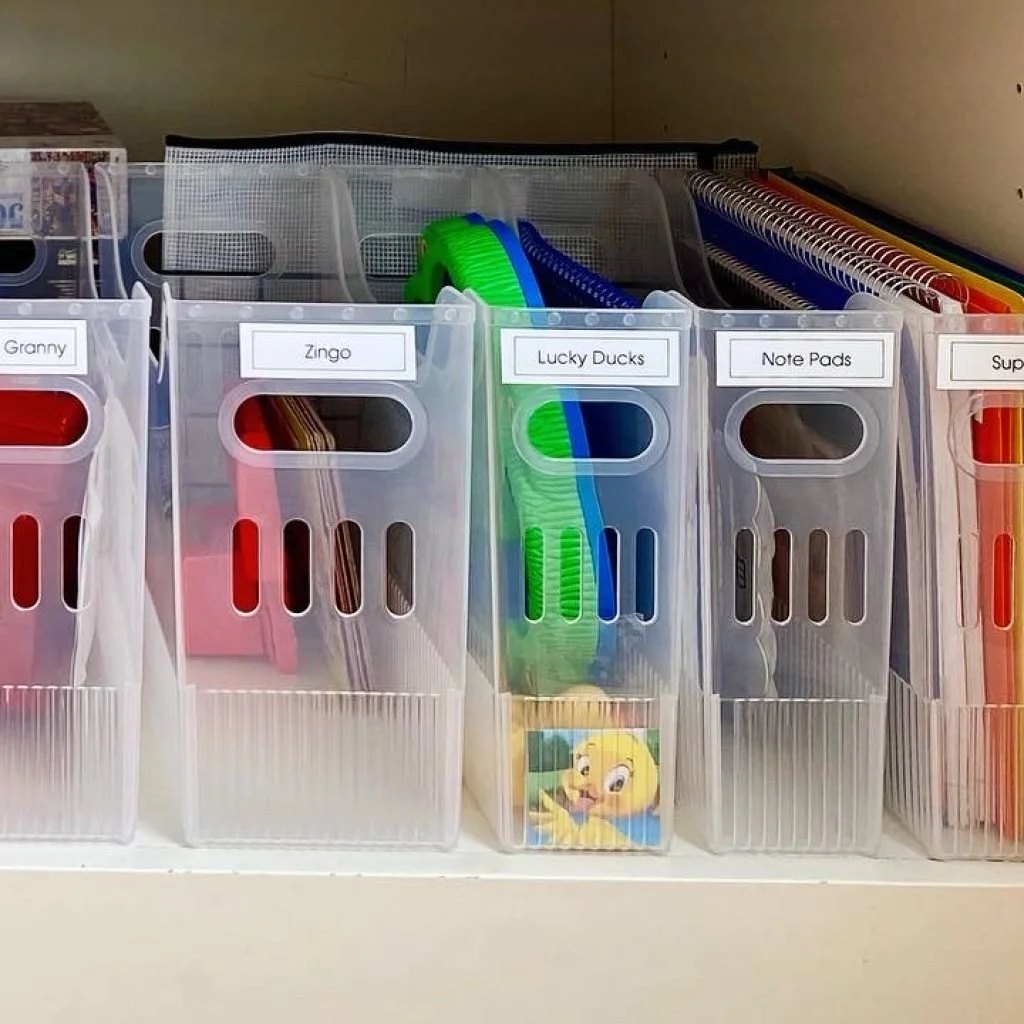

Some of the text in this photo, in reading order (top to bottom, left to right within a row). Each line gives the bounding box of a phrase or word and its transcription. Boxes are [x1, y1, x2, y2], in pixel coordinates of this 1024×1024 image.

[4, 339, 67, 357] Granny
[304, 344, 352, 363] Zingo
[538, 349, 645, 368] Lucky Ducks
[761, 352, 852, 367] Note Pads
[992, 354, 1024, 373] Sup
